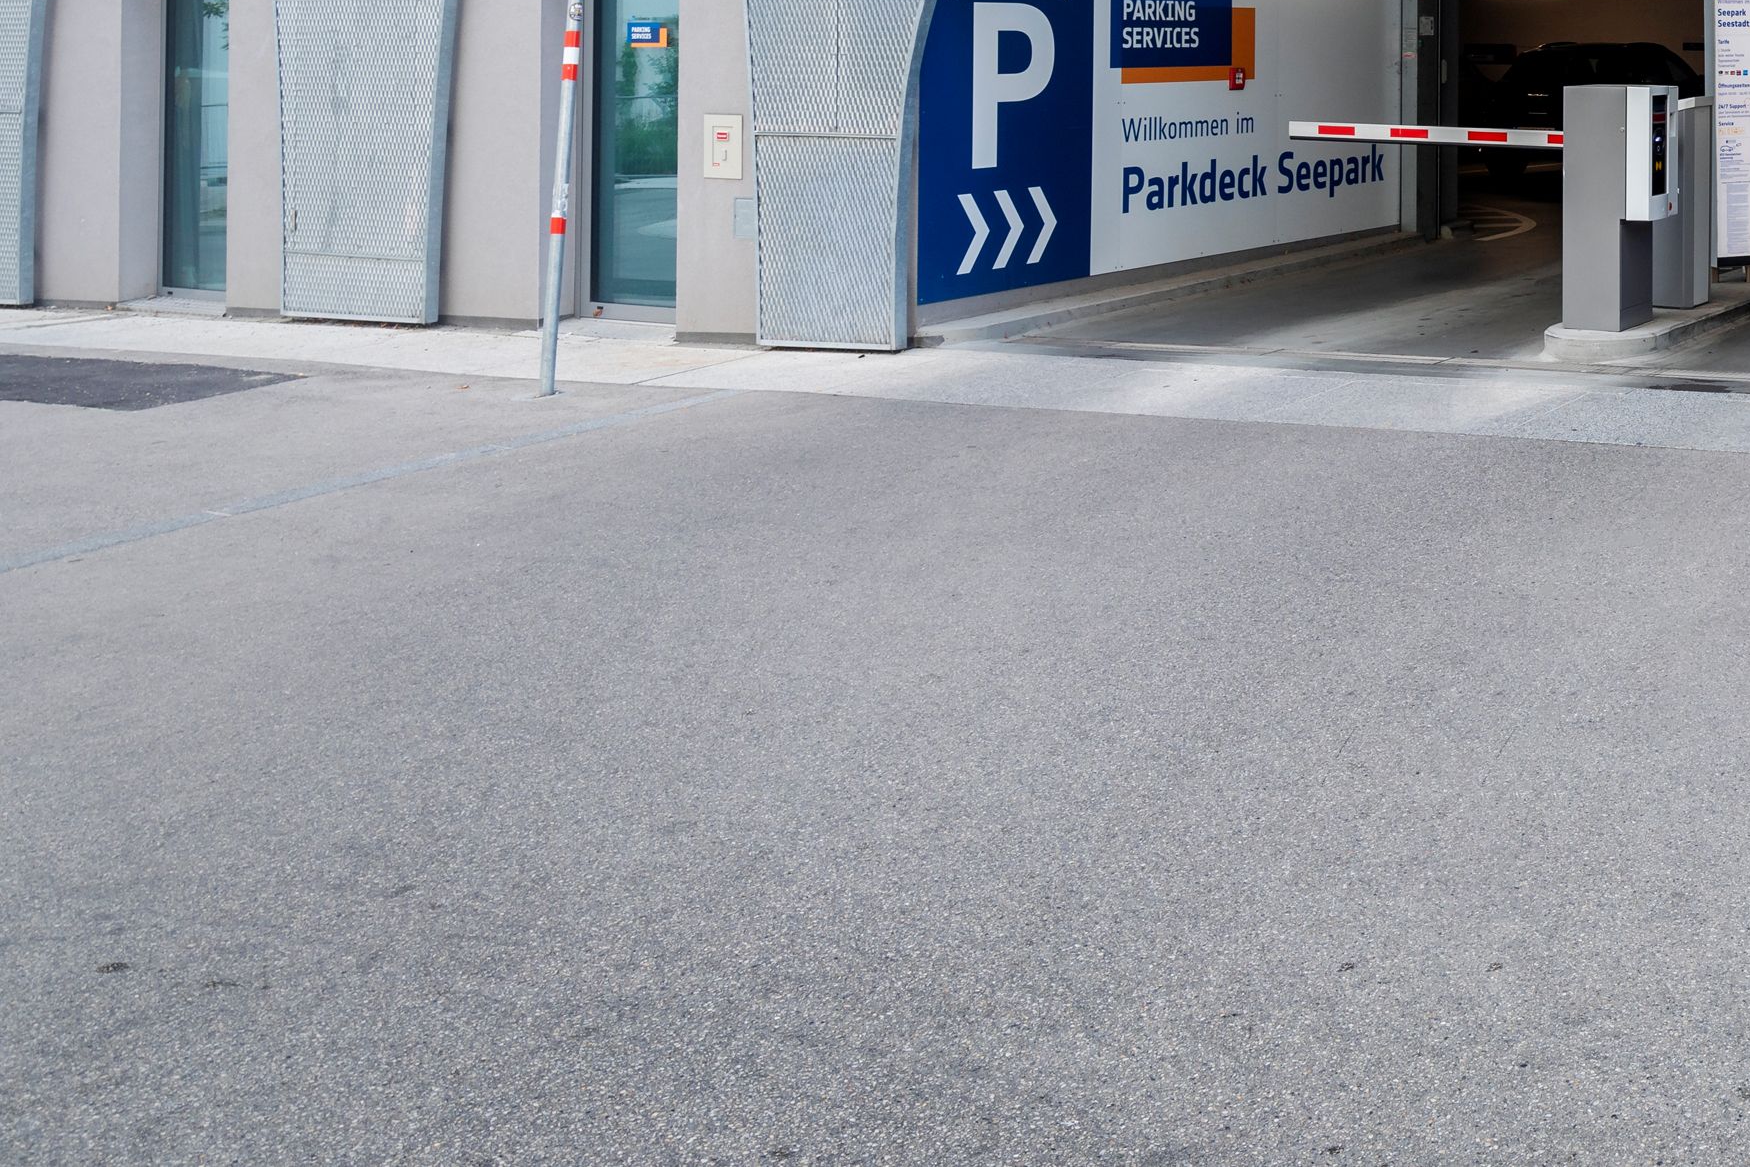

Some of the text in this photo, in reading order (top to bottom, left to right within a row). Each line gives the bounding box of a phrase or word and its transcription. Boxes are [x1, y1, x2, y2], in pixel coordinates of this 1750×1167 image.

[1122, 0, 1196, 22] PARKING
[1717, 8, 1747, 18] Seepark
[1717, 19, 1750, 28] Seestadt
[1122, 27, 1200, 49] SERVICES
[972, 1, 1055, 170] P
[1121, 111, 1254, 143] Willkommen im
[1121, 144, 1384, 214] Parkdeck Seepark
